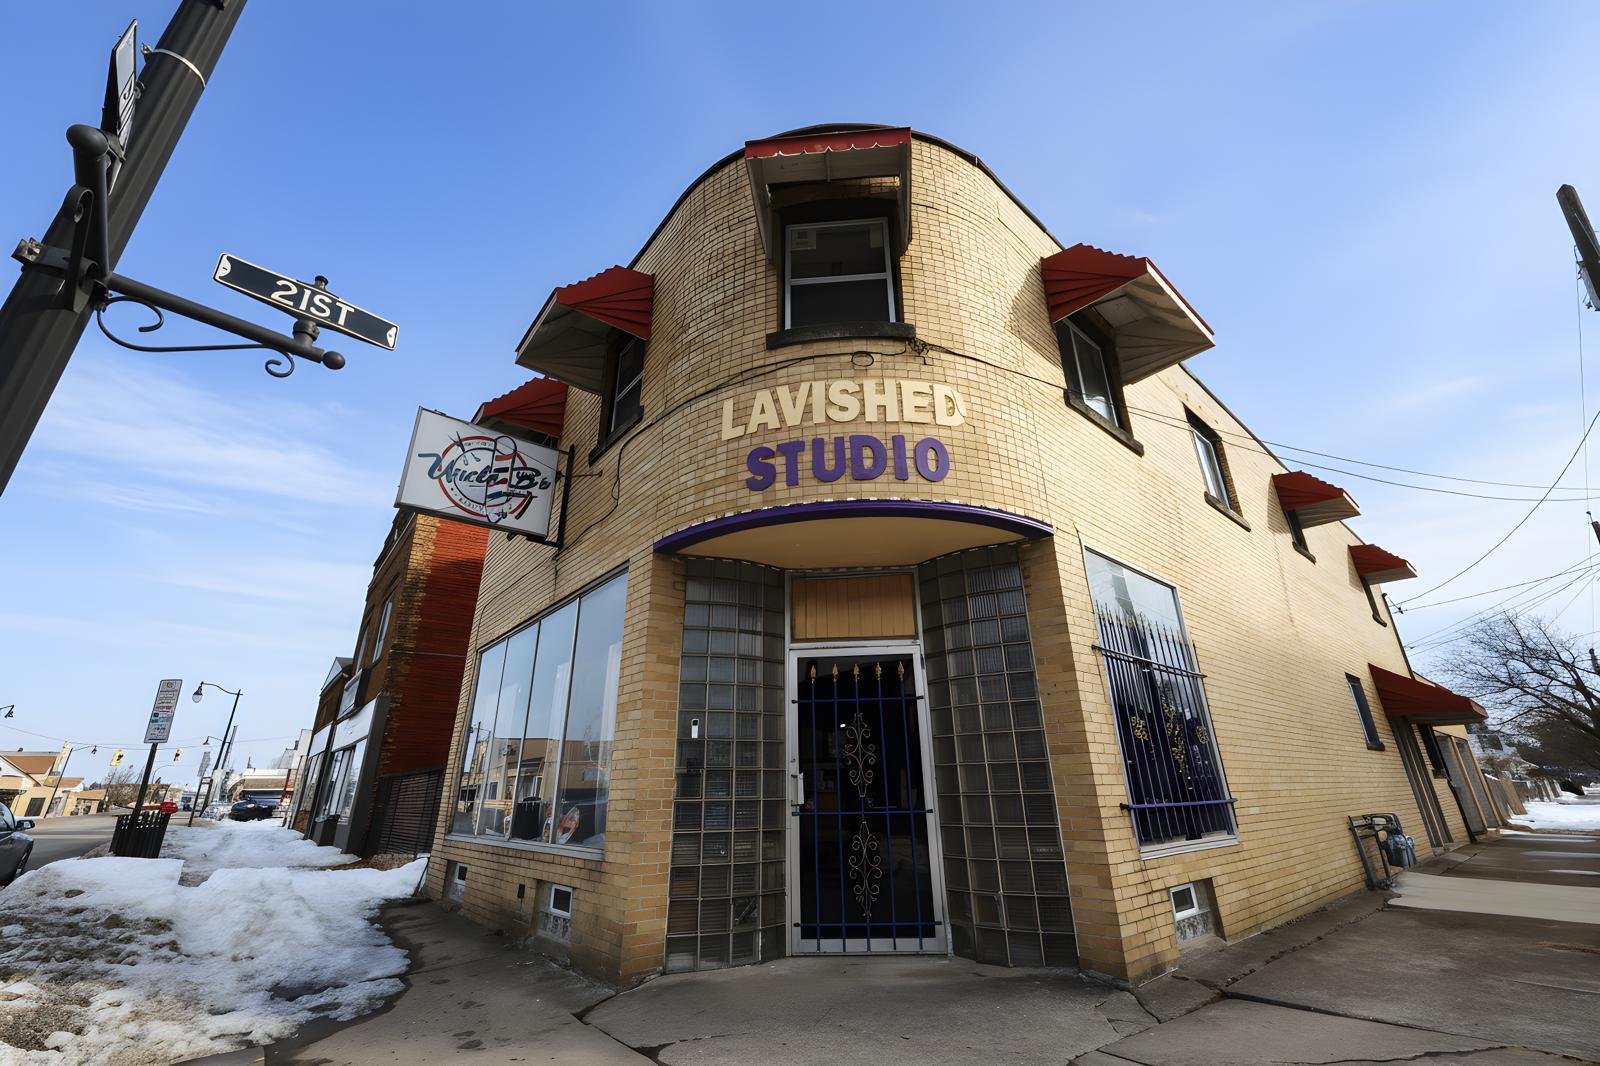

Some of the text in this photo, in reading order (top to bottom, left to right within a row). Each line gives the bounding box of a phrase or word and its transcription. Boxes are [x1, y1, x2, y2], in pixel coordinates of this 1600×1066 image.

[270, 279, 355, 326] 21ST
[721, 377, 967, 441] LAVISHED
[745, 434, 950, 492] STUDIO
